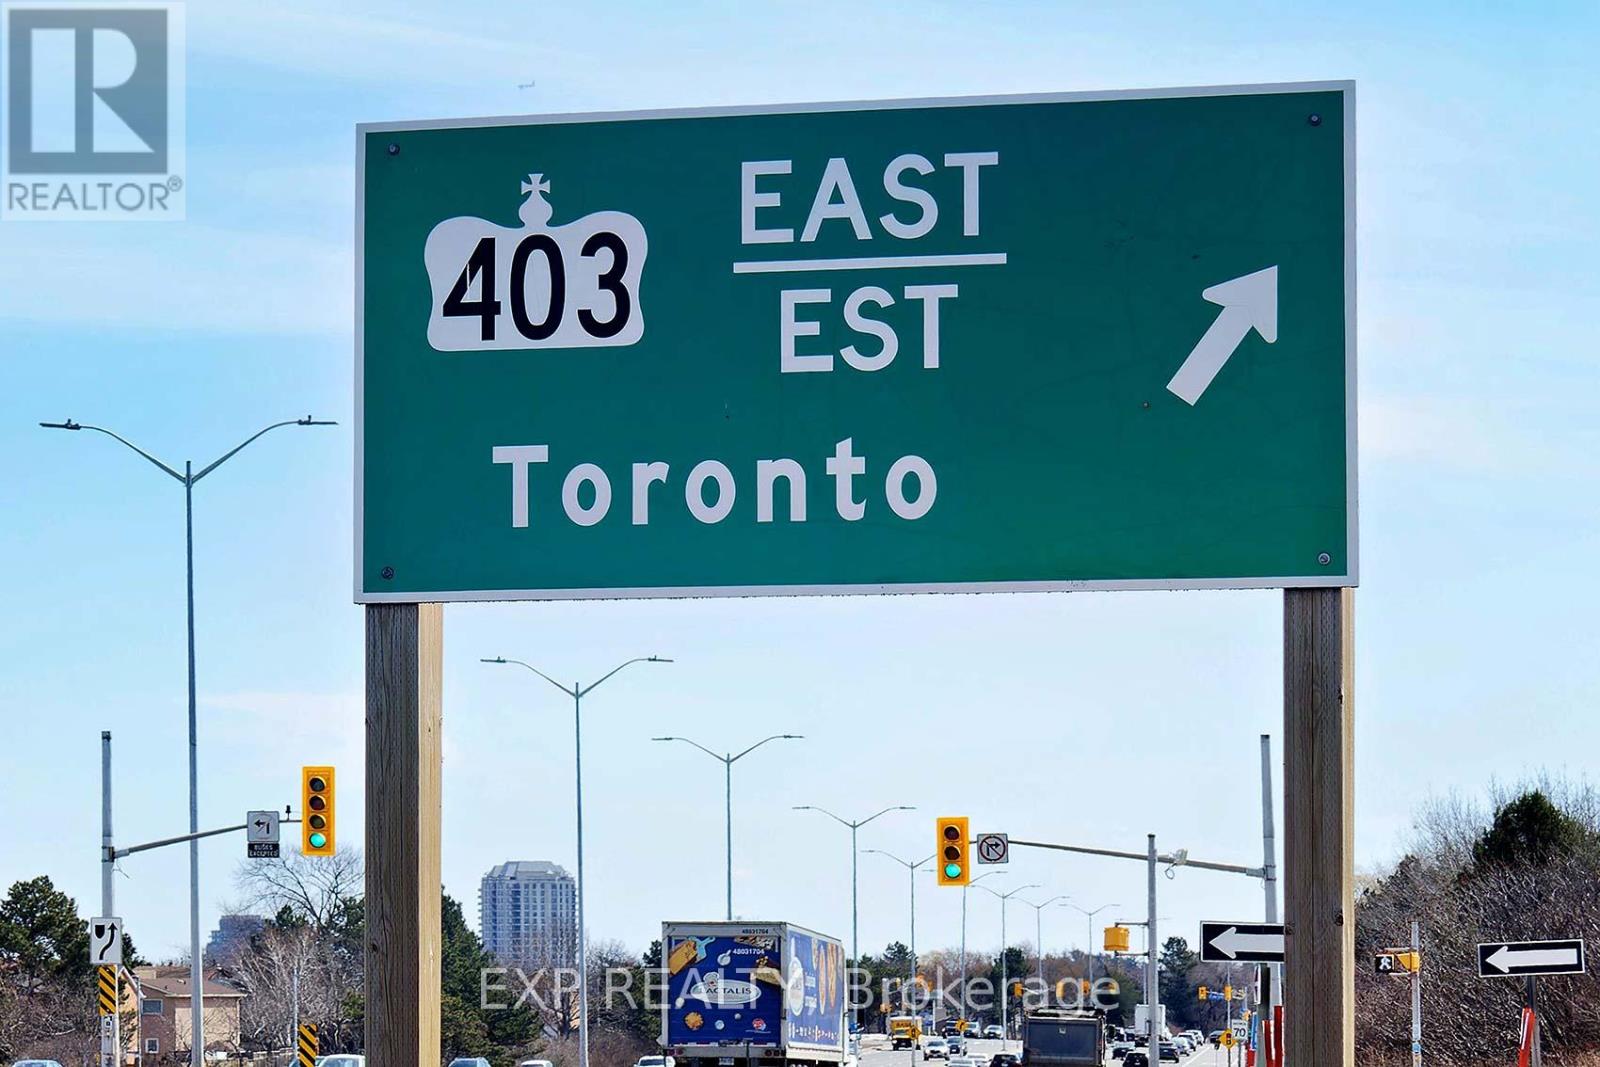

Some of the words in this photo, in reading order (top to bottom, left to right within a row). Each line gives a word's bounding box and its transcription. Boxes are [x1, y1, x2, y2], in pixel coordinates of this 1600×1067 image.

[741, 151, 999, 244] EAST
[442, 231, 632, 342] 403
[780, 284, 959, 374] EST
[492, 437, 937, 528] Toronto
[1233, 1027, 1246, 1038] 70
